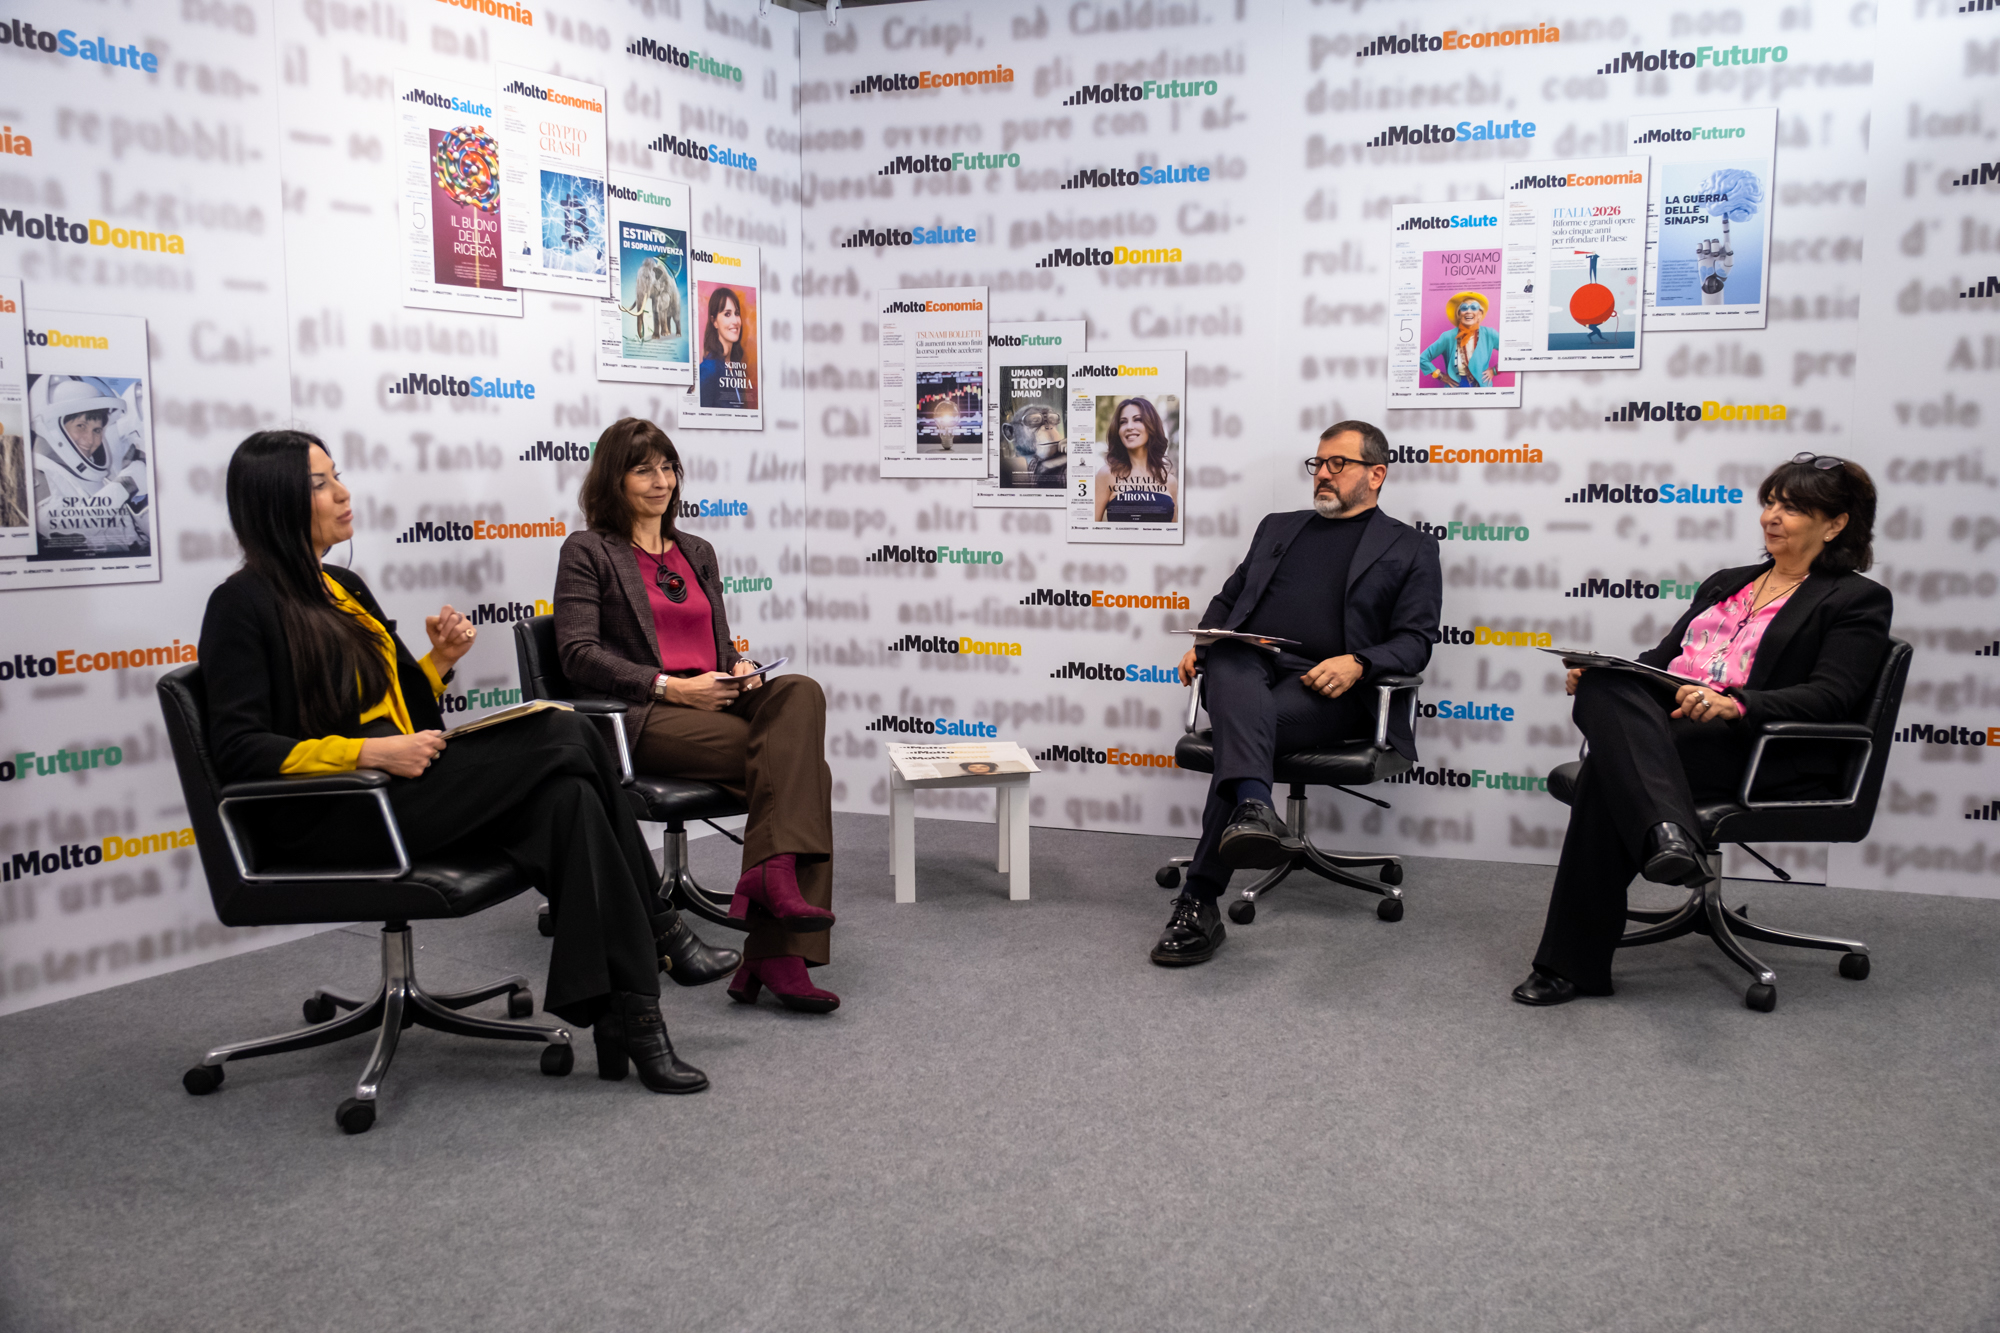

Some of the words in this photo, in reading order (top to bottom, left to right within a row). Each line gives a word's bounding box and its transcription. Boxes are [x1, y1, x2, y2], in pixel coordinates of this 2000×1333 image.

[0, 18, 158, 73] oltoSalute
[1376, 22, 1561, 55] MoltoEconomia
[642, 36, 742, 84] MoltoFuturo
[1620, 45, 1788, 74] MoltoFuturo
[866, 64, 1015, 92] MoltoEconomia
[414, 87, 492, 118] MoltoSalute
[513, 79, 603, 114] MoltoEconomia
[1081, 79, 1218, 105] MoltoFuturo
[539, 121, 587, 143] CRYPTO
[1387, 119, 1537, 147] MoltoSalute
[1648, 126, 1746, 144] MoltoFuturo
[539, 136, 581, 157] CRASH
[663, 133, 758, 172] MoltoSalute
[895, 151, 1021, 174] MoltoFuturo
[1078, 163, 1211, 188] MoltoSalute
[1523, 170, 1643, 190] MoltoEconomia
[608, 183, 671, 207] MoltoFuturo
[1665, 195, 1680, 205] LA
[1683, 193, 1729, 205] GUERRA
[412, 201, 426, 230] 5
[1664, 215, 1709, 225] SINAPSI
[1665, 205, 1700, 215] DELLE
[451, 215, 460, 228] IL
[462, 216, 498, 233] BUONO
[1409, 214, 1498, 231] MoltoSalute
[1552, 219, 1583, 228] Riforme
[1588, 217, 1613, 227] grandi
[1614, 217, 1636, 226] opere
[1552, 228, 1568, 236] solo
[1568, 227, 1594, 238] cinque
[1594, 226, 1611, 234] anni
[458, 229, 492, 245] DELLA
[622, 226, 667, 244] ESTINTO
[858, 226, 977, 247] MoltoSalute
[1552, 237, 1564, 246] per
[1565, 235, 1599, 244] rifondare
[1606, 234, 1628, 242] Paese
[454, 242, 497, 259] RICERCA
[622, 240, 631, 249] DI
[631, 241, 684, 256] SOPRAVVIVENZA
[1053, 245, 1183, 268] MoltoDonna
[1441, 253, 1461, 264] NOI
[1463, 251, 1501, 264] SIAMO
[1450, 264, 1496, 276] GIOVANI
[893, 298, 983, 313] MoltoEconomia
[988, 334, 1063, 347] MoltoFuturo
[1399, 318, 1414, 343] 5
[1011, 369, 1043, 377] UMANO
[1082, 364, 1159, 378] MoltoDonna
[409, 372, 535, 400] MoltoSalute
[718, 376, 754, 390] STORIA
[1011, 377, 1065, 390] TROPPO
[1011, 390, 1042, 398] UMANO
[1627, 400, 1787, 423] MoltoDonna
[1388, 443, 1544, 465] oltoEconomia
[1078, 483, 1087, 497] 3
[1587, 483, 1744, 504] MoltoSalute
[62, 496, 112, 507] SPAZIO
[678, 498, 749, 519] ltoSalute
[49, 517, 127, 530] SAMANTHA
[415, 516, 566, 544] MoltoEconomia
[882, 544, 1004, 565] MoltoFuturo
[722, 575, 773, 595] Futuro
[1036, 588, 1190, 611] MoltoEconomia
[904, 634, 1022, 657] MoltoDonna
[1432, 625, 1553, 648] oltoDonna
[0, 638, 199, 682] oltoEconomia
[1067, 661, 1182, 684] MoltoSalut
[1416, 699, 1515, 722] toSalute
[881, 714, 998, 738] MoltoSalute
[0, 745, 123, 783] oFuturo
[12, 827, 197, 882] MoltoDonna
